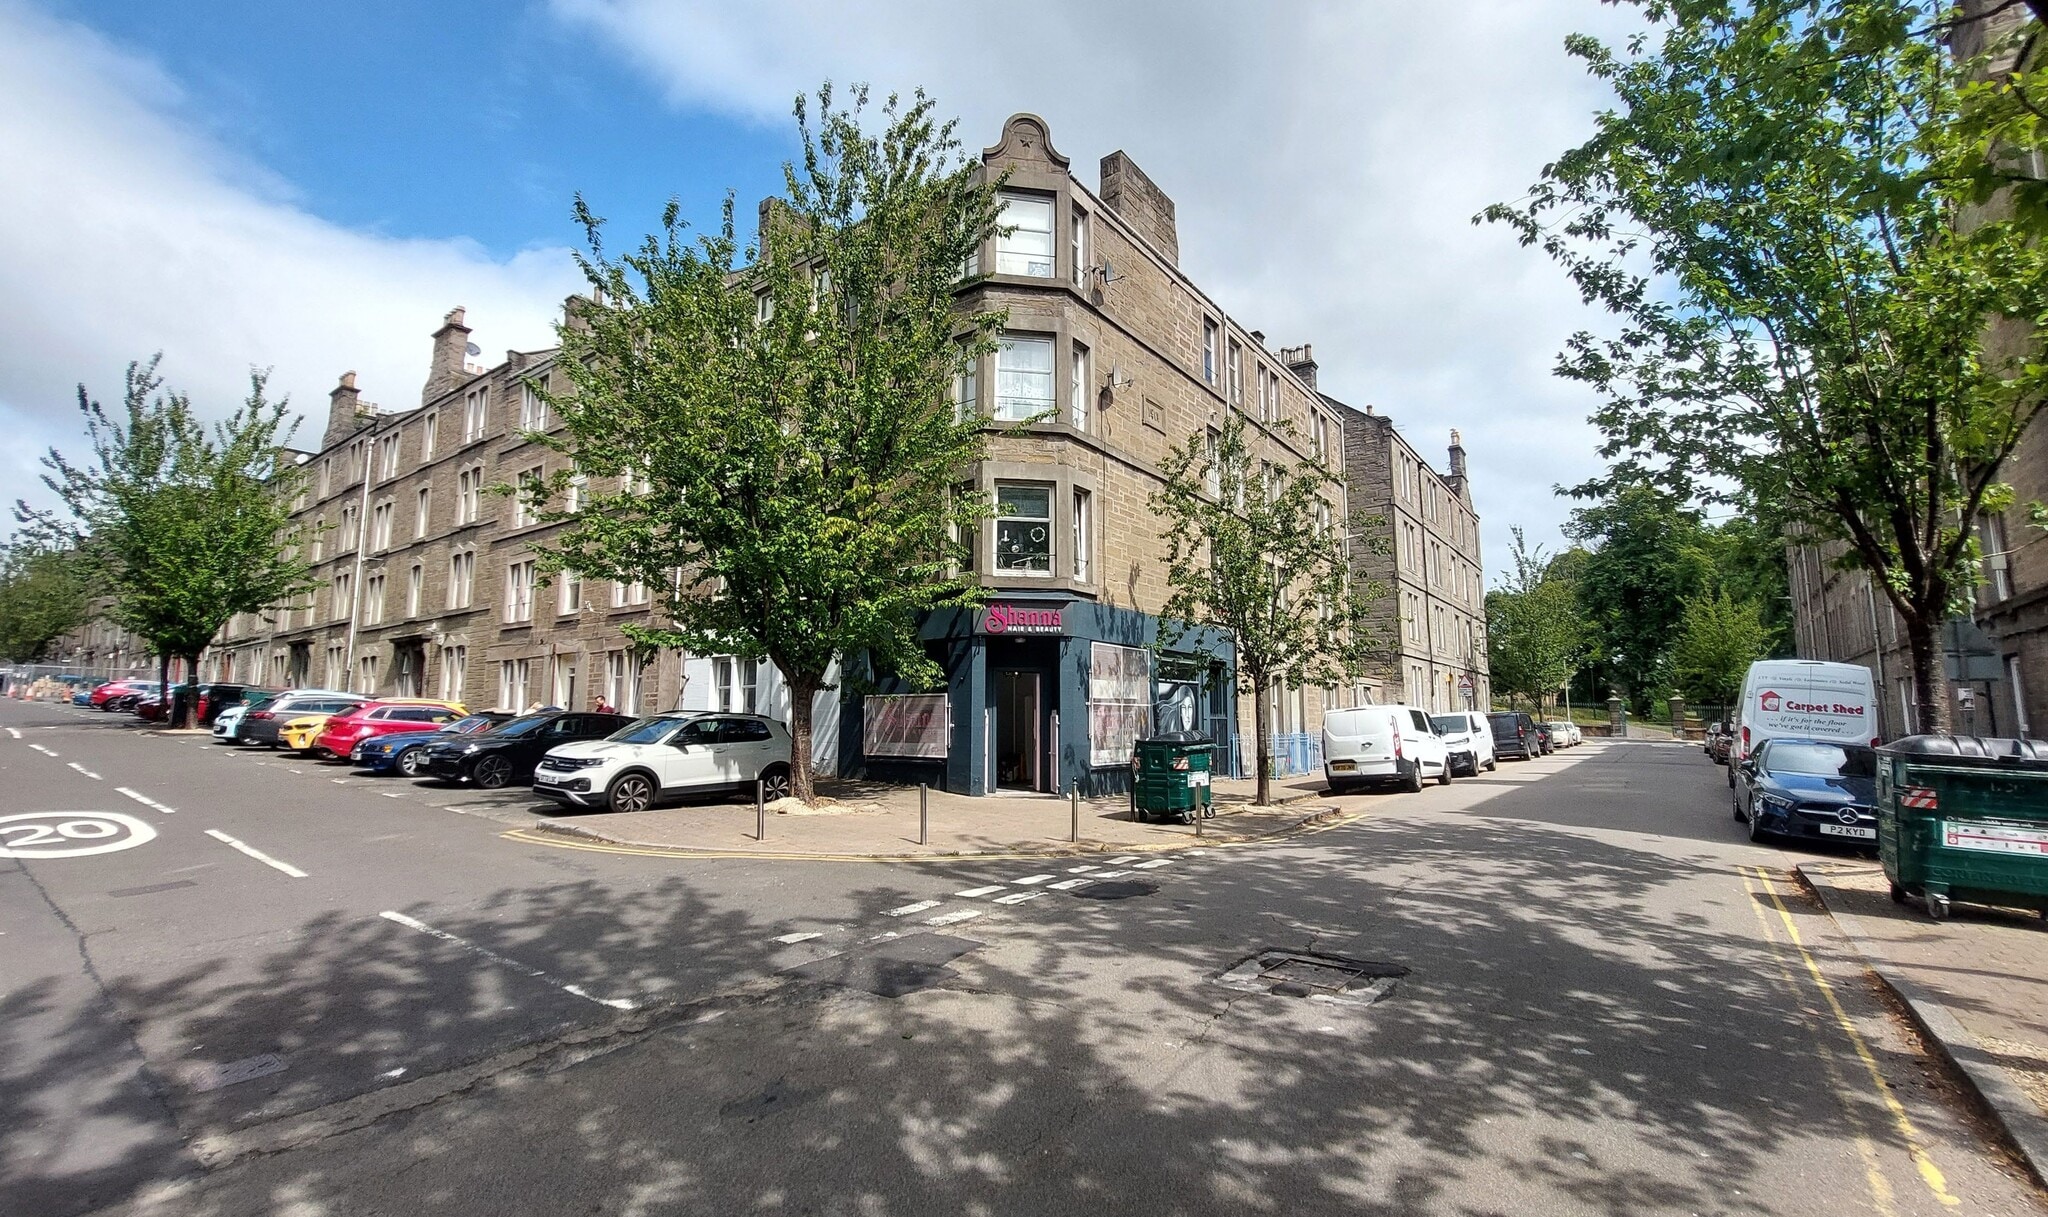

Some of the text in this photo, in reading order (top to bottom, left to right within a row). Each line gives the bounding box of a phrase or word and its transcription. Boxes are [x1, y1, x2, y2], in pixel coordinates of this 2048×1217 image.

[984, 604, 1062, 634] Shanna
[1786, 701, 1864, 715] Carpet Shed
[1779, 715, 1787, 723] if
[1800, 716, 1812, 725] for
[1827, 719, 1847, 727] floor
[1789, 723, 1802, 731] got
[1811, 725, 1841, 733] covered
[0, 820, 118, 847] 20
[1830, 825, 1843, 834] P2
